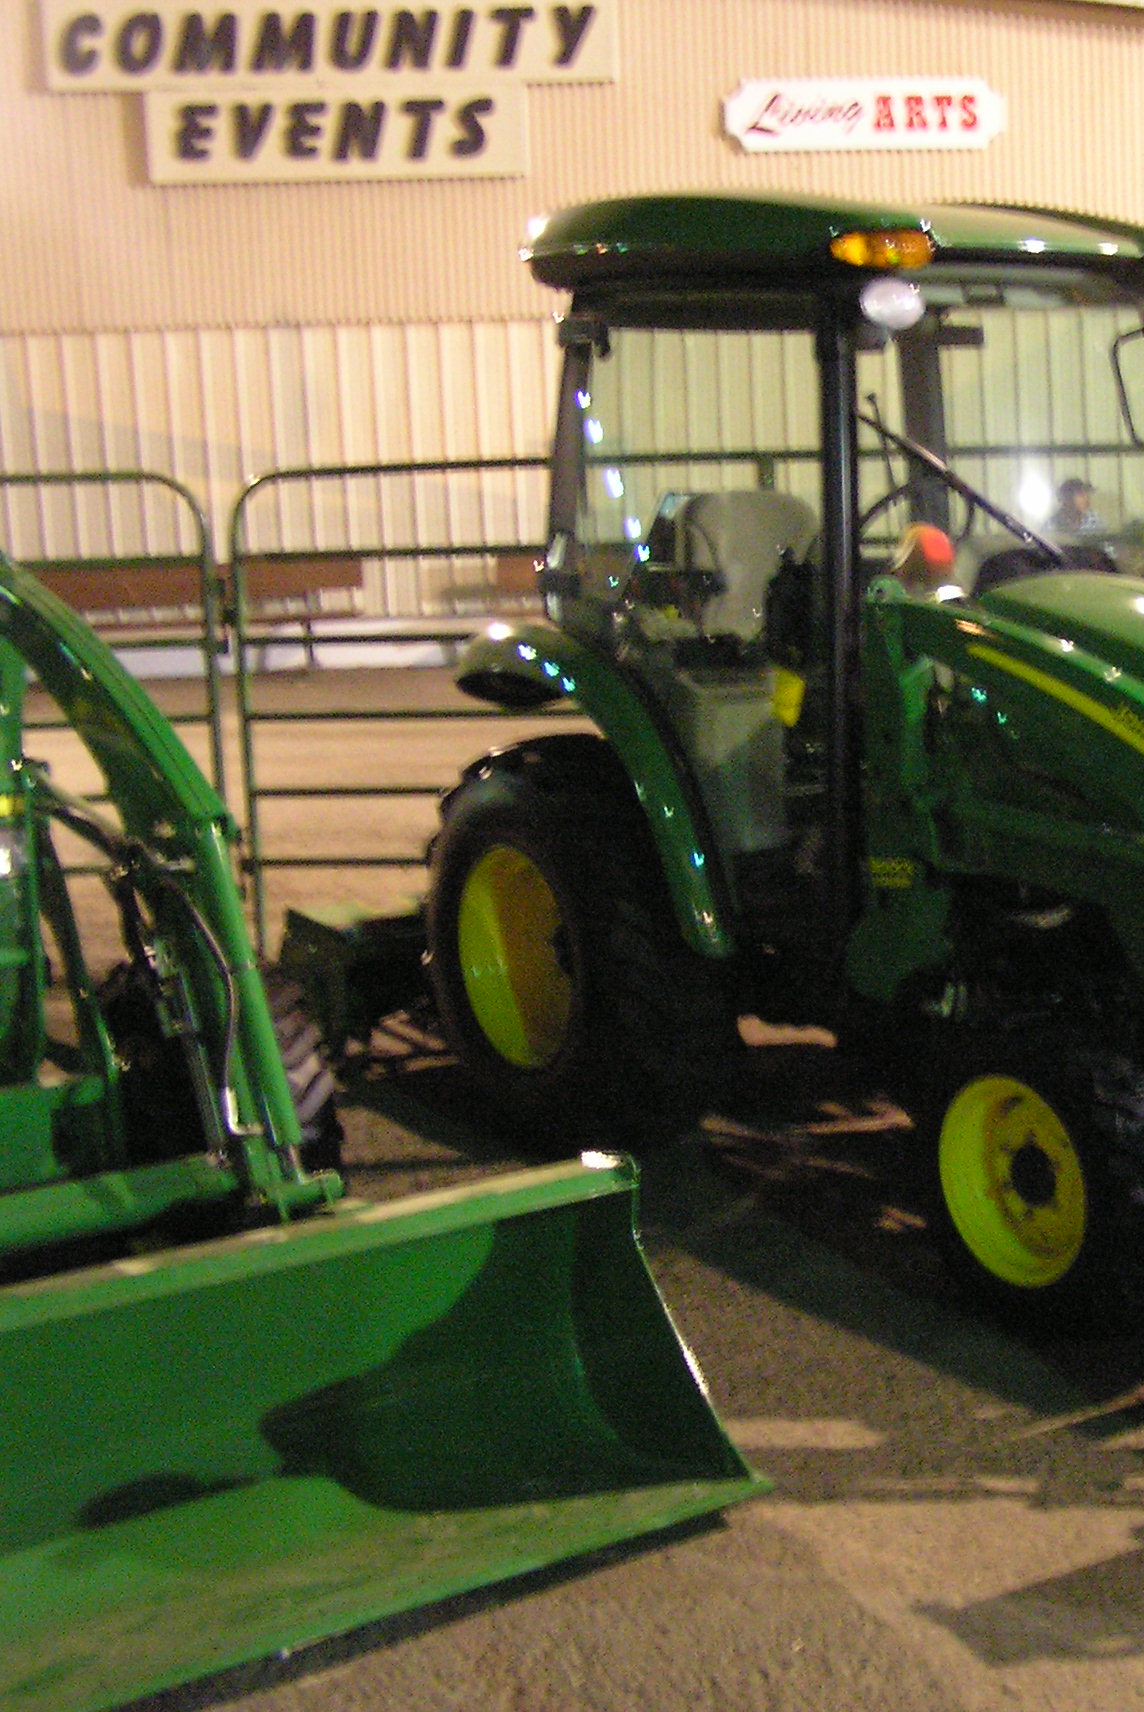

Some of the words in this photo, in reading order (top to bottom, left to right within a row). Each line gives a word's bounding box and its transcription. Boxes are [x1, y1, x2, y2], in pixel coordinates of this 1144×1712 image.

[59, 5, 596, 75] COMMUNITY
[174, 99, 494, 161] EVENTS
[746, 93, 863, 135] Living
[874, 95, 978, 130] ARTS
